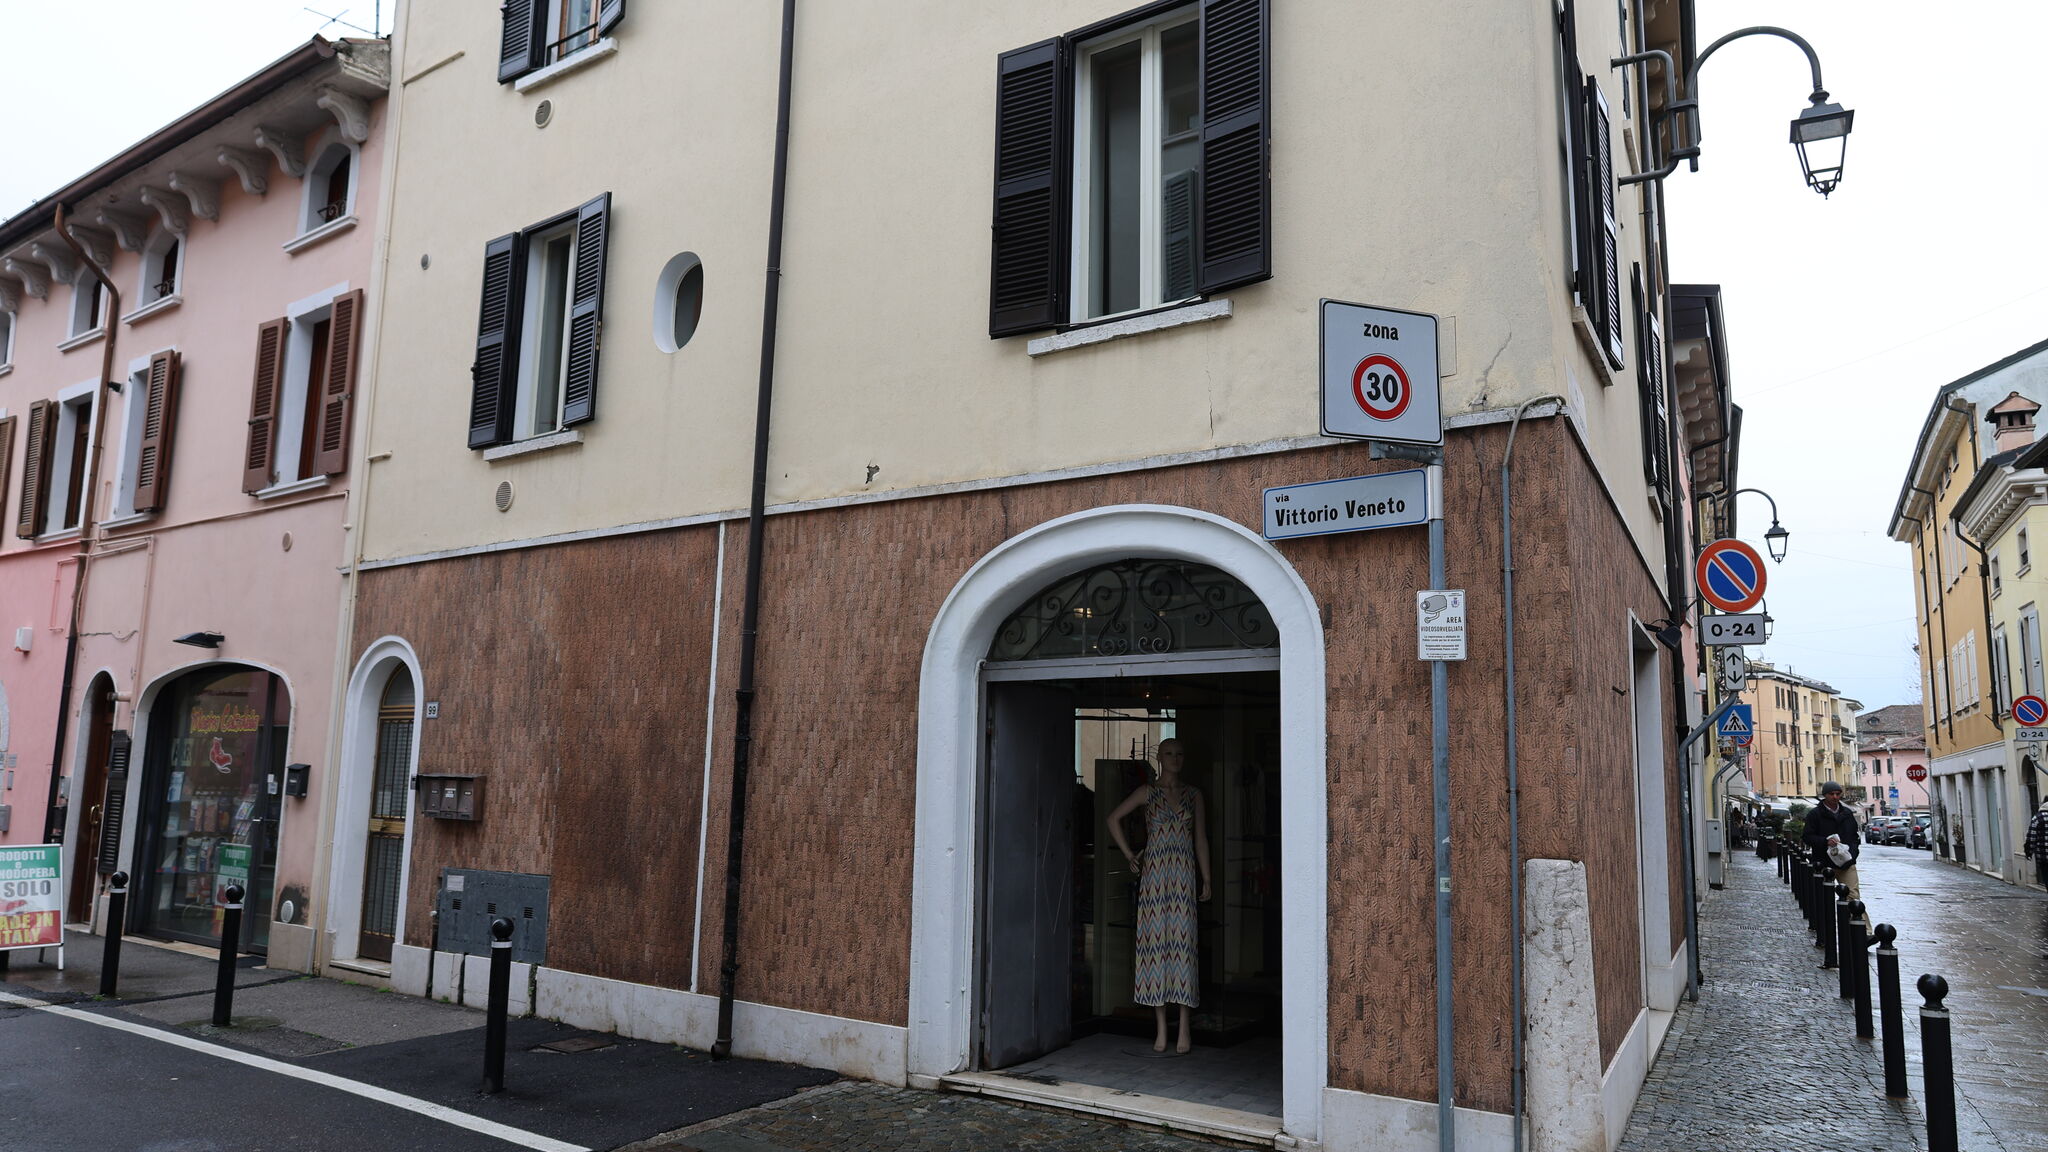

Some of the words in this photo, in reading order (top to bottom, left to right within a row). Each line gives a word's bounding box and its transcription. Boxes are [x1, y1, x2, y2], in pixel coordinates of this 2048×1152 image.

[1363, 323, 1399, 341] zona
[1366, 372, 1399, 403] 30
[1275, 493, 1290, 503] via
[1275, 504, 1338, 527] Vittorio
[1345, 496, 1406, 519] Veneto
[1446, 616, 1462, 624] AREA
[1710, 622, 1756, 637] 0-24
[428, 705, 437, 715] 99
[1907, 769, 1926, 777] STOP
[4, 880, 51, 898] SOLO
[36, 911, 54, 927] IN
